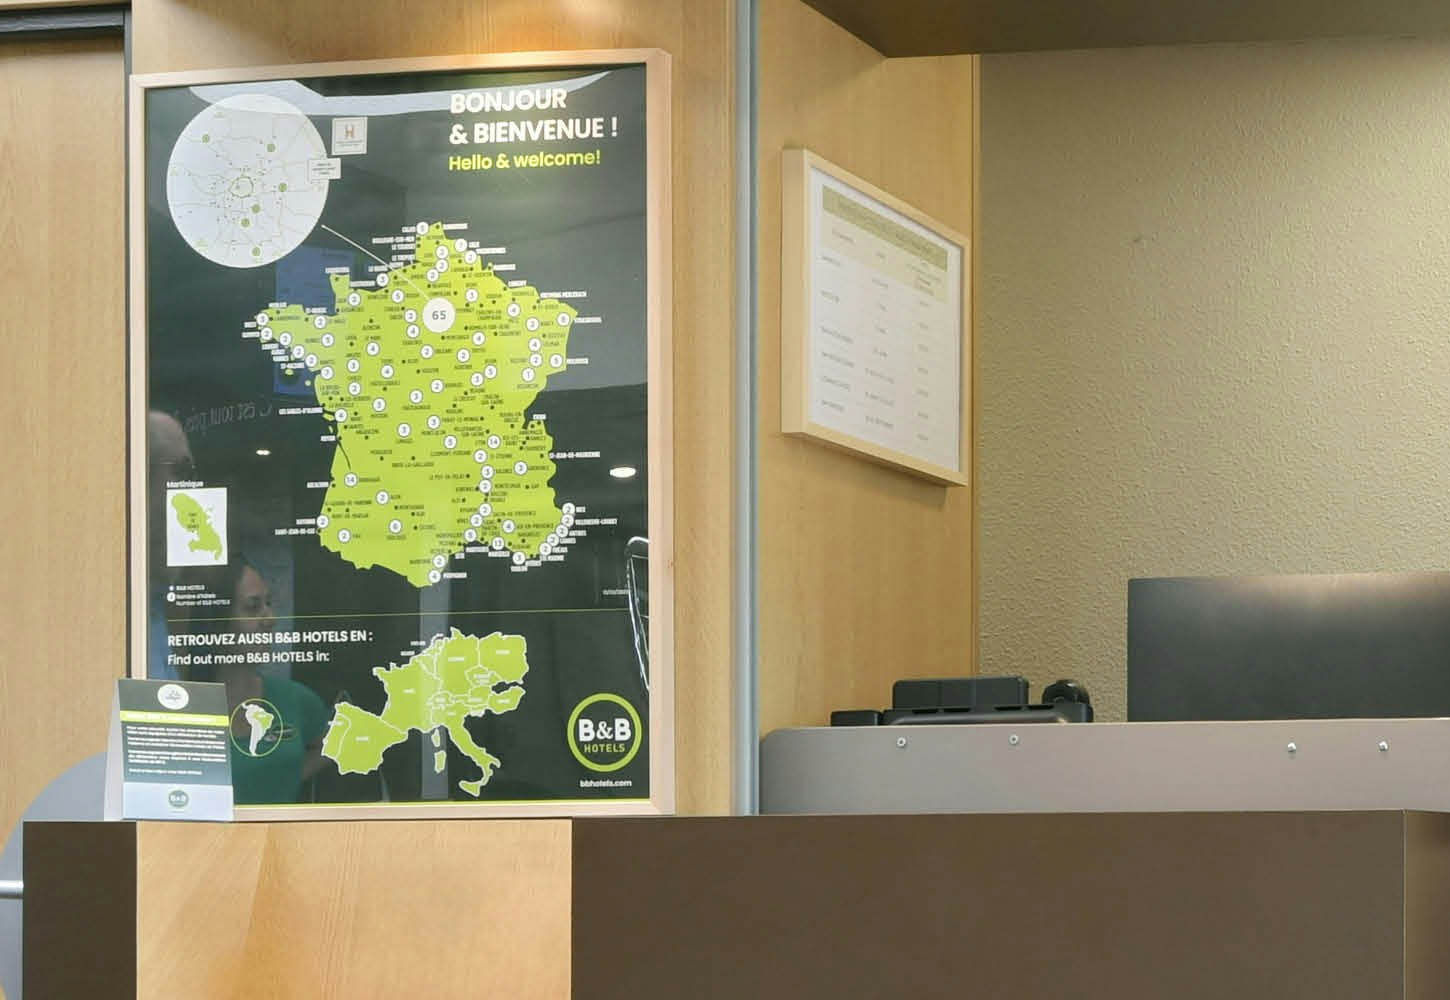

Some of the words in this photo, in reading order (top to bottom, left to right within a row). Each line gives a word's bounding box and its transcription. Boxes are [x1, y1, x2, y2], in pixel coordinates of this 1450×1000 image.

[450, 89, 568, 114] BONJOUR
[449, 124, 469, 145] &
[474, 118, 604, 144] BIENVENUE
[611, 116, 618, 137] !
[449, 154, 492, 171] Hello
[495, 153, 510, 169] &
[513, 150, 601, 168] welcome!
[431, 310, 447, 320] 65
[167, 633, 236, 647] RETROUVEZ
[237, 633, 273, 645] AUSSI
[274, 632, 301, 644] B&B
[302, 631, 348, 643] HOTELS
[350, 630, 367, 642] EN
[167, 653, 191, 666] Find
[193, 654, 212, 665] out
[214, 654, 245, 664] more
[246, 652, 270, 663] B&B
[272, 651, 314, 663] HOTELS
[316, 650, 330, 662] in:
[578, 718, 632, 742] B&B
[583, 743, 626, 754] HOTELS
[579, 779, 633, 788] bbhotels.com
